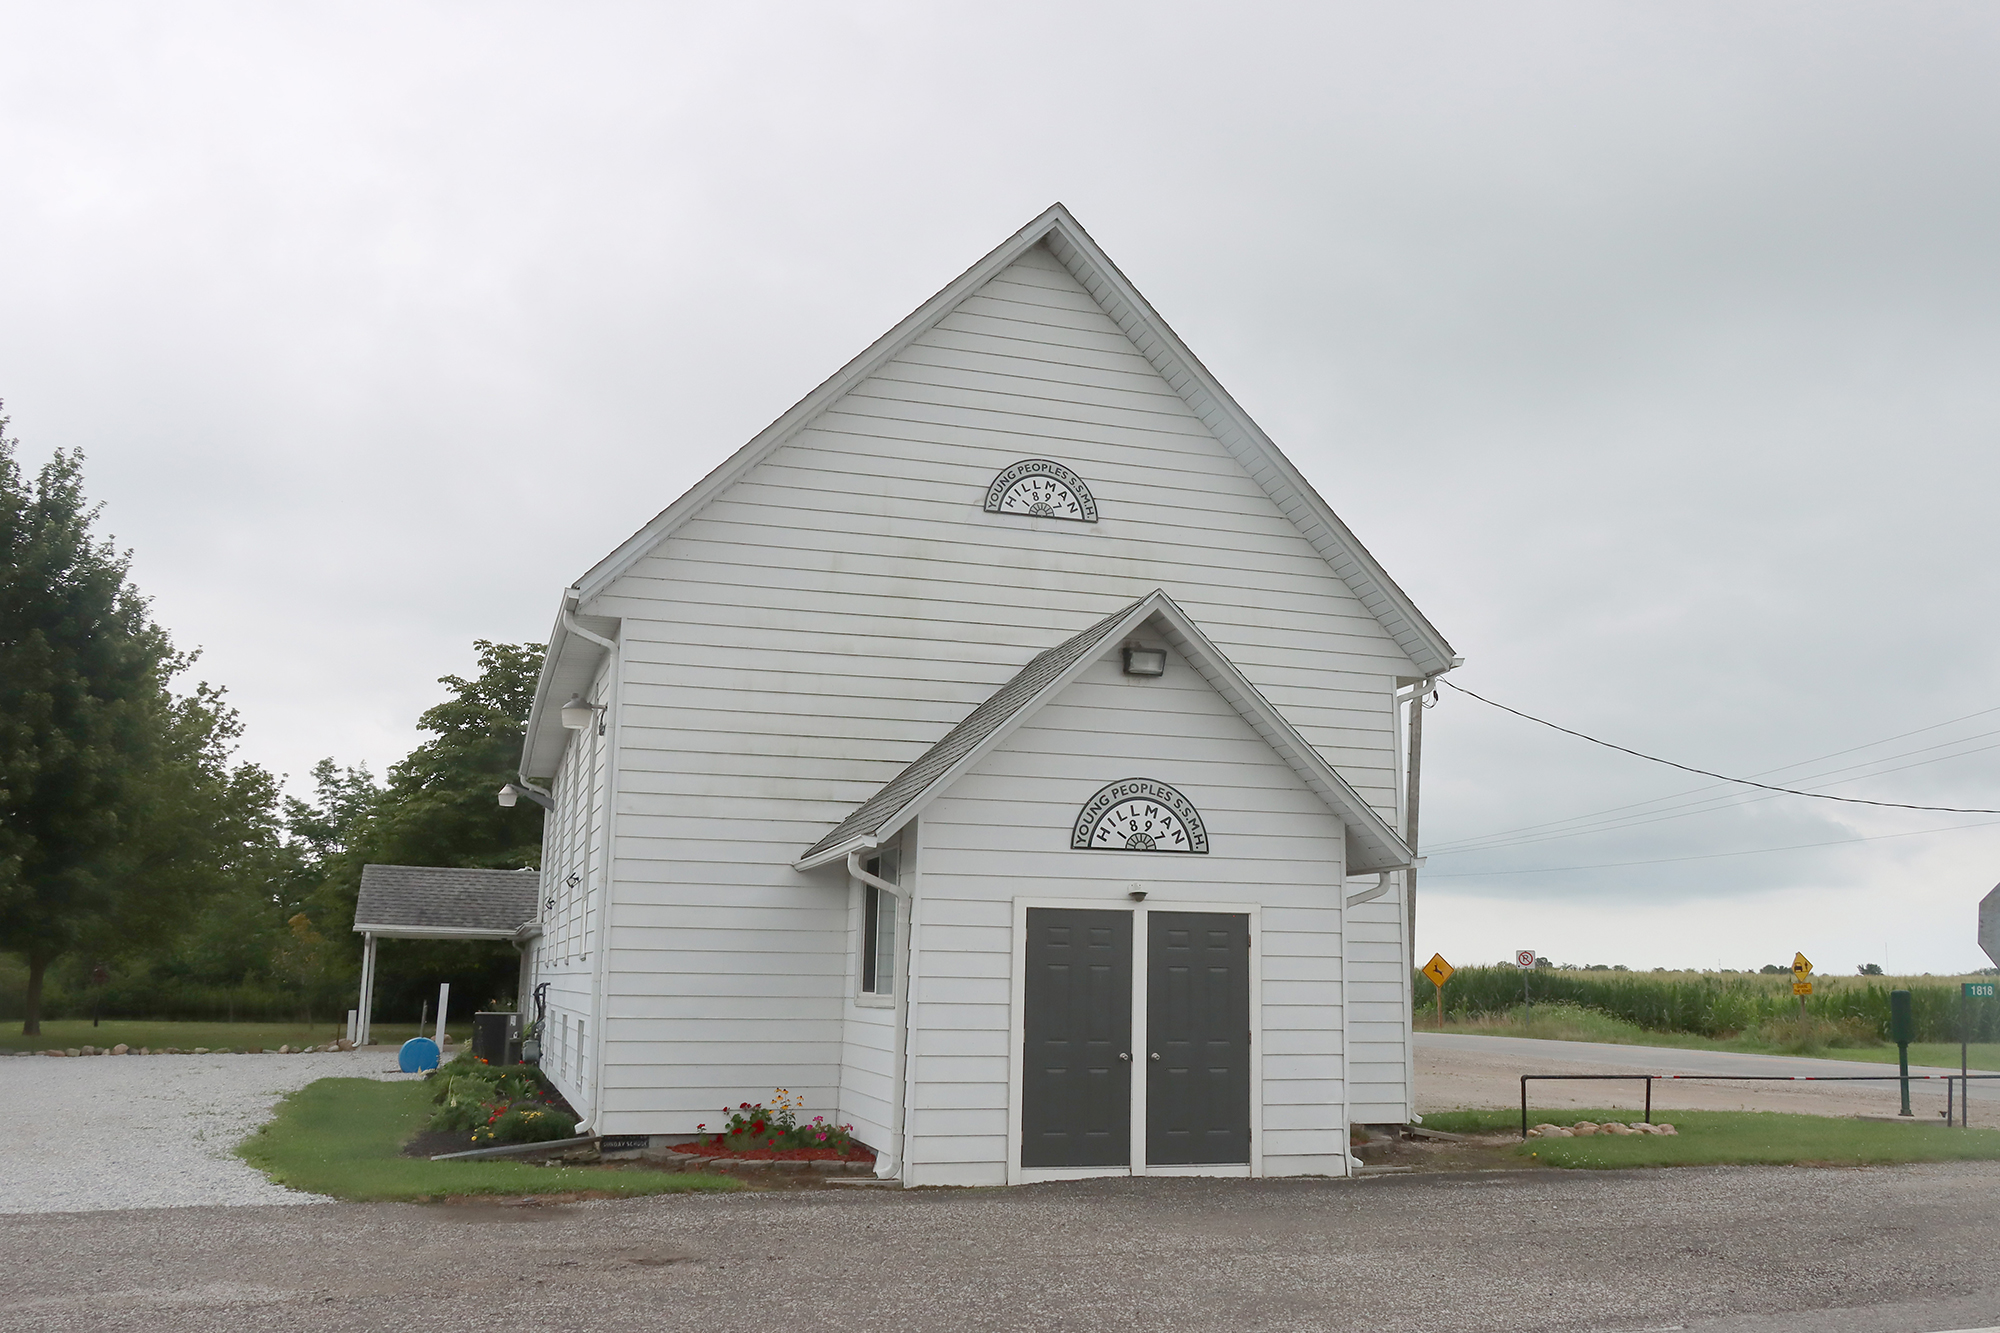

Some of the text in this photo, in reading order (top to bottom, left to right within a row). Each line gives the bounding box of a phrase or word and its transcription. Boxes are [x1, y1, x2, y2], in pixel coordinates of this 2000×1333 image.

[988, 463, 1095, 518] YOUNG PEOPLES S.S.M.H.
[1005, 480, 1079, 514] HILLMAN
[1022, 491, 1062, 509] 1897
[1075, 783, 1205, 849] YOUNG PEOPLES S.S.M.H.
[1096, 805, 1185, 845] HILLMAN
[1117, 819, 1166, 839] 1897
[1971, 985, 1993, 996] 1818
